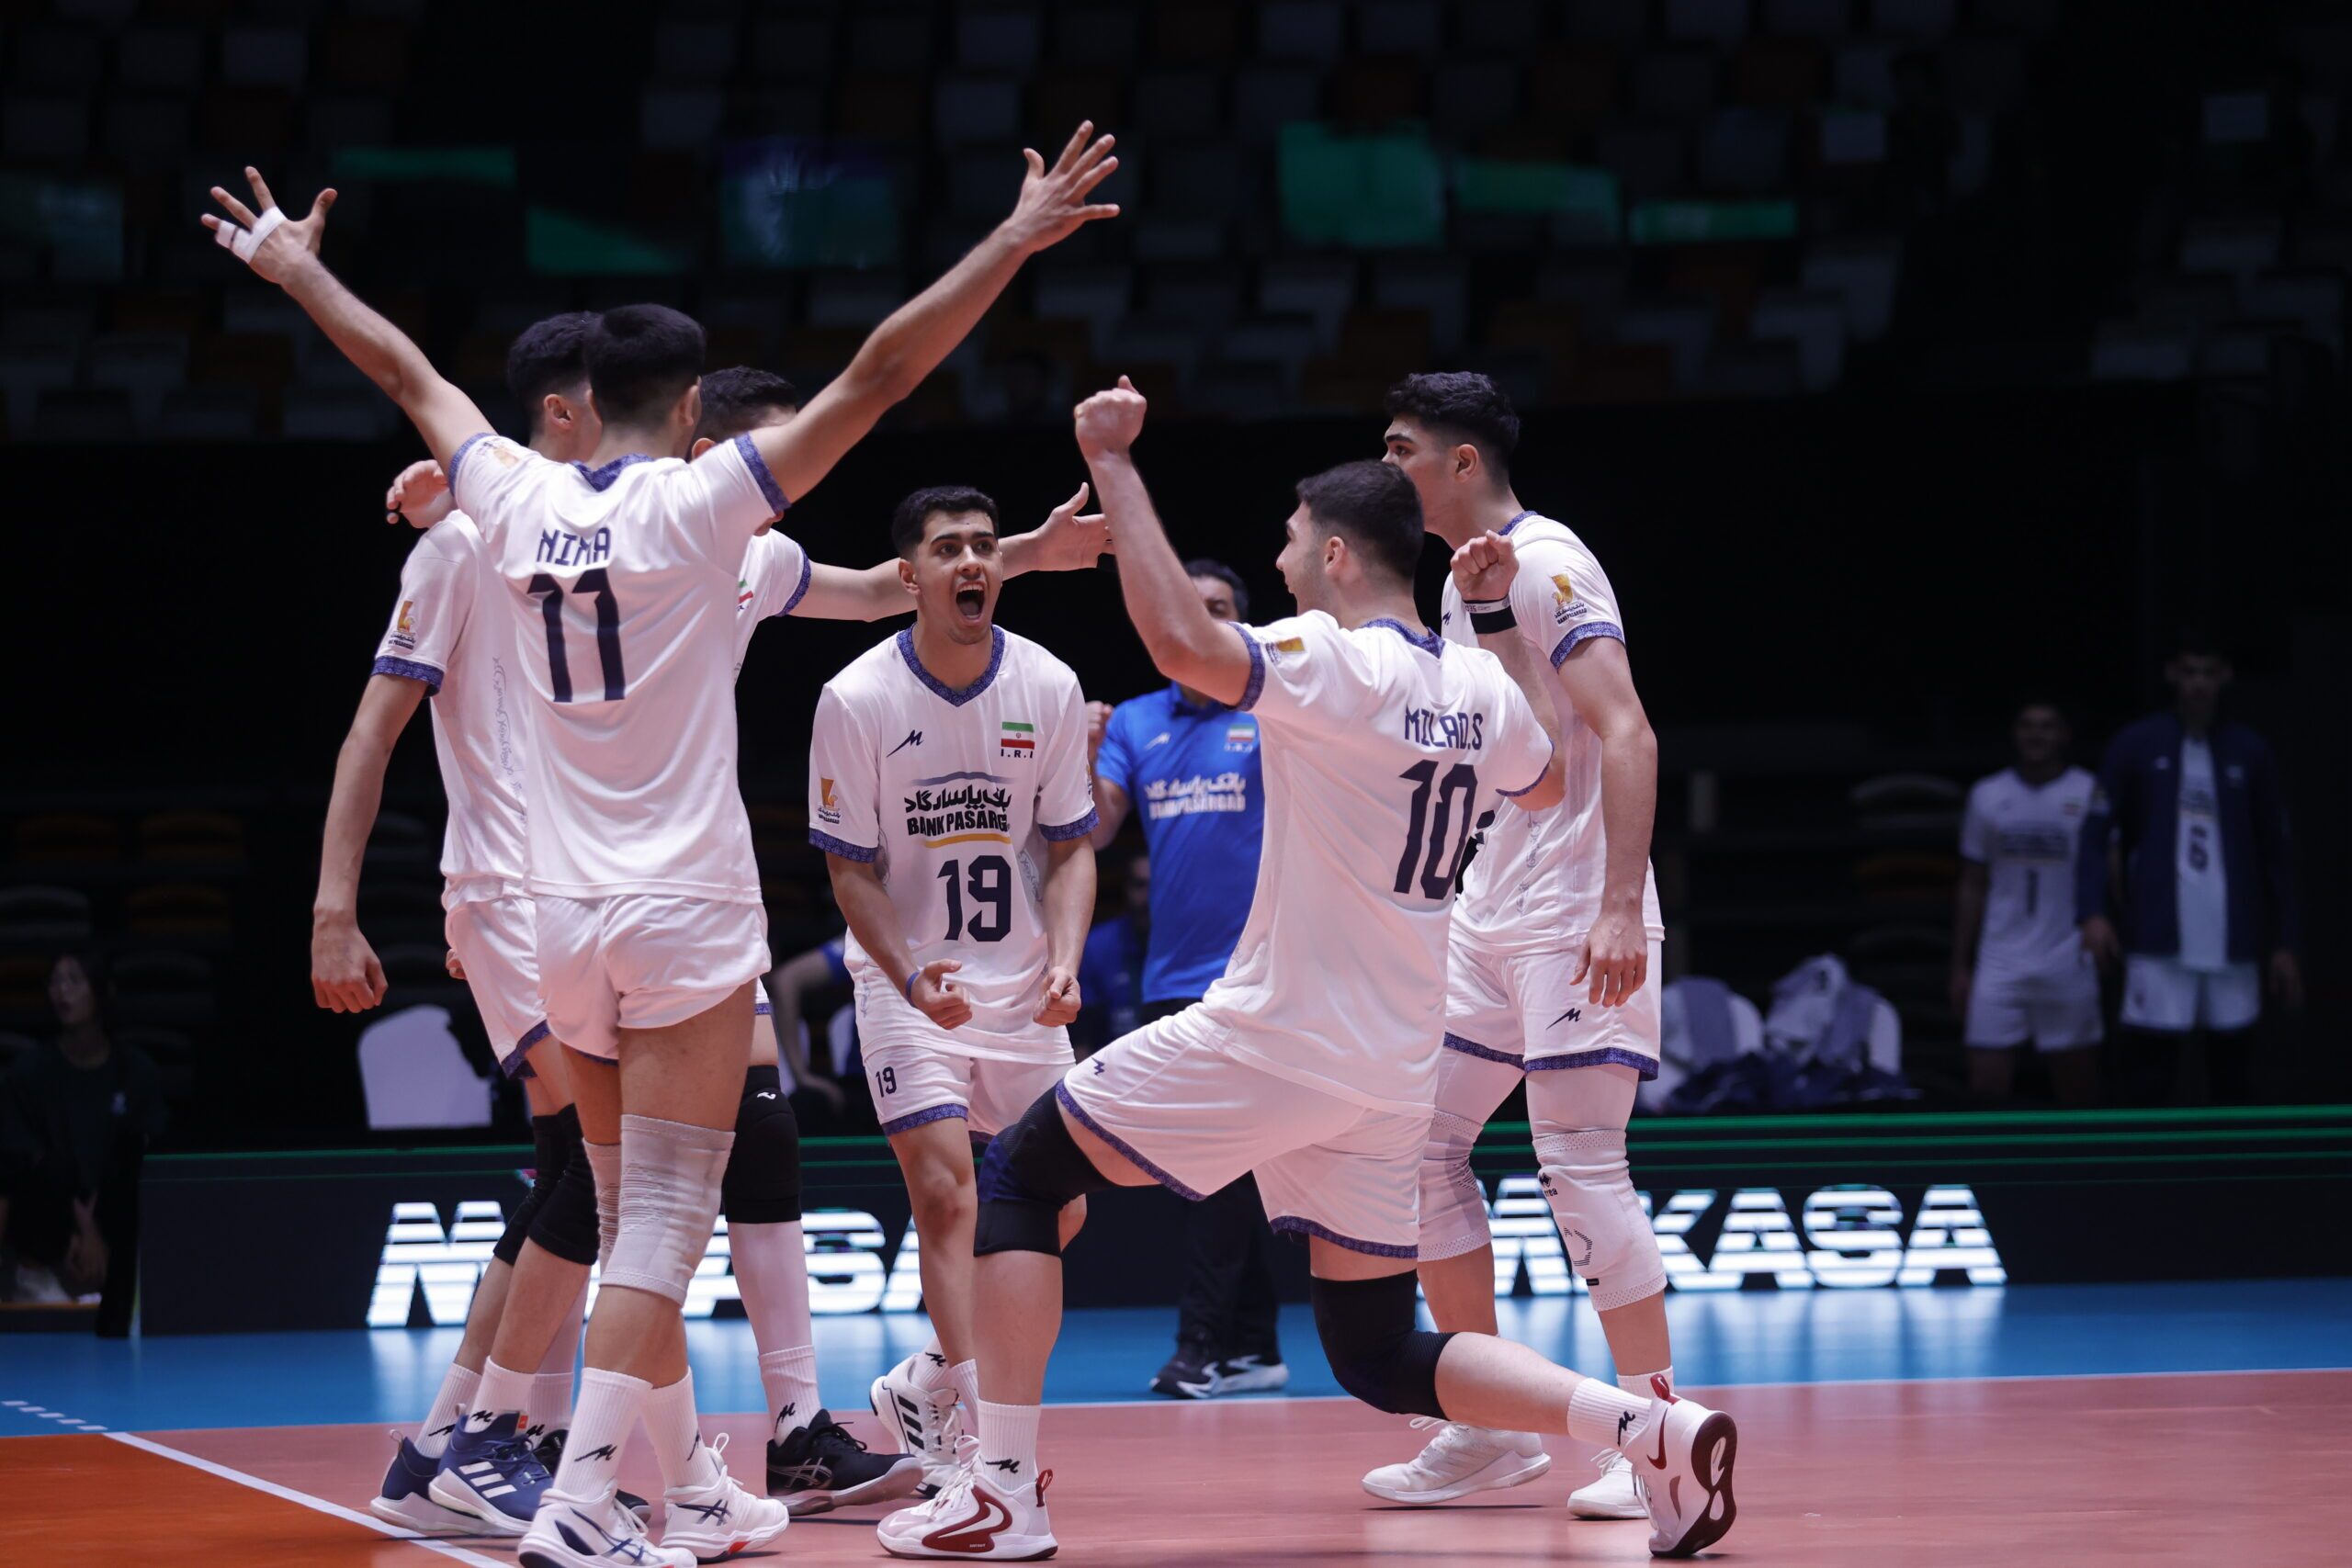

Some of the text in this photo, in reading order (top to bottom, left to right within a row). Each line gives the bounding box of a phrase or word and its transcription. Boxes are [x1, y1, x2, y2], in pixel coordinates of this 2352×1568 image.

[537, 527, 612, 566] NIMA
[527, 568, 626, 703] 11
[907, 810, 1008, 837] BANK PASARG
[1393, 759, 1478, 900] 10
[937, 855, 1012, 942] 19
[876, 1066, 897, 1098] 19
[1416, 1174, 2009, 1297] MKASA
